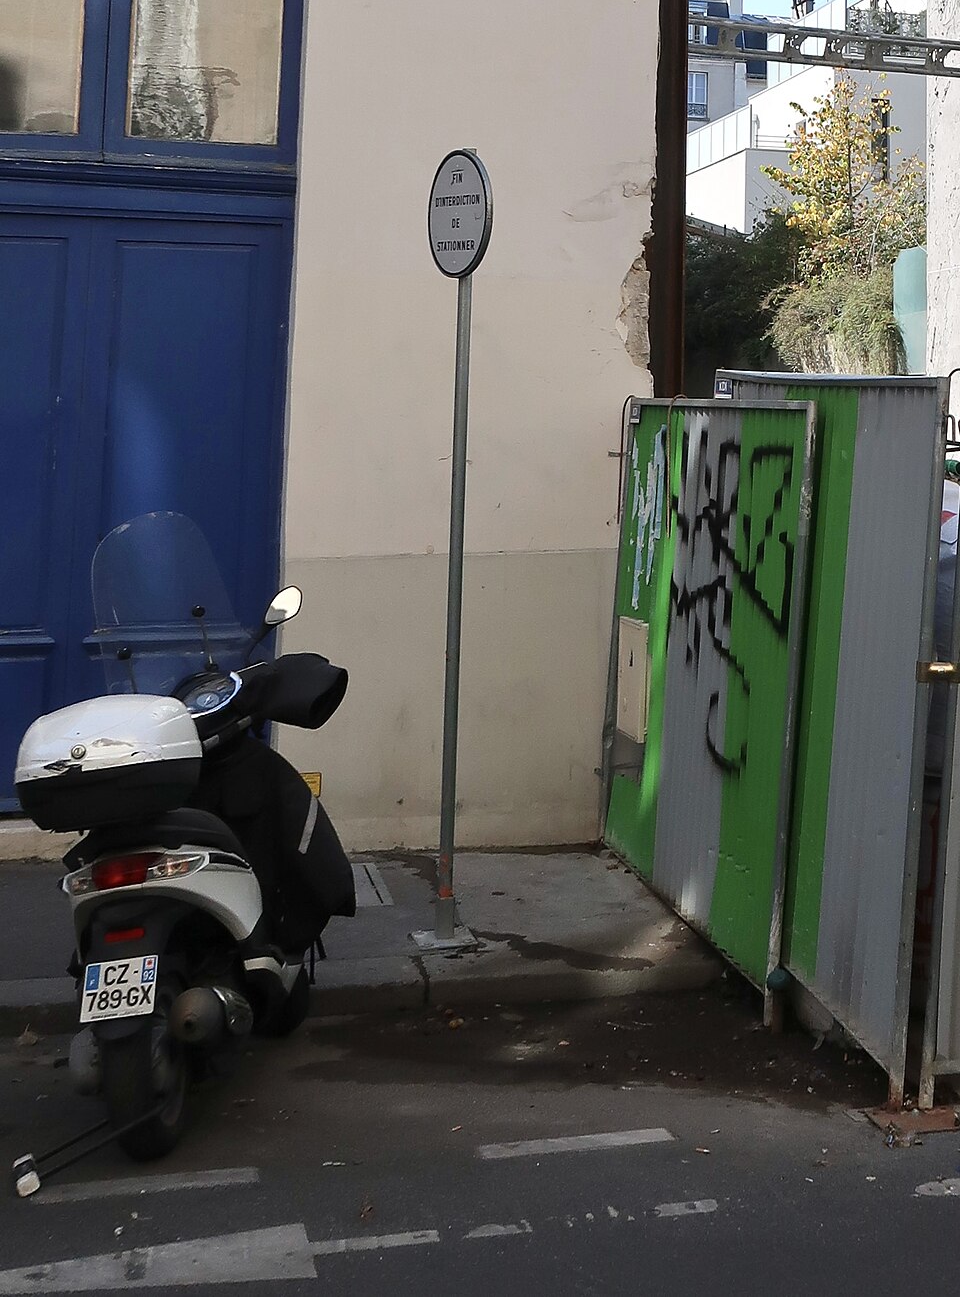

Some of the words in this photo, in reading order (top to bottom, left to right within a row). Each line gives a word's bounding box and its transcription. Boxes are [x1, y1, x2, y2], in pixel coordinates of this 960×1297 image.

[451, 173, 463, 185] FIN
[436, 195, 480, 207] D'INTERDICTION
[452, 218, 460, 228] DE
[437, 240, 475, 252] STATIONNER
[143, 970, 154, 981] 92
[86, 984, 153, 1012] 789-GX
